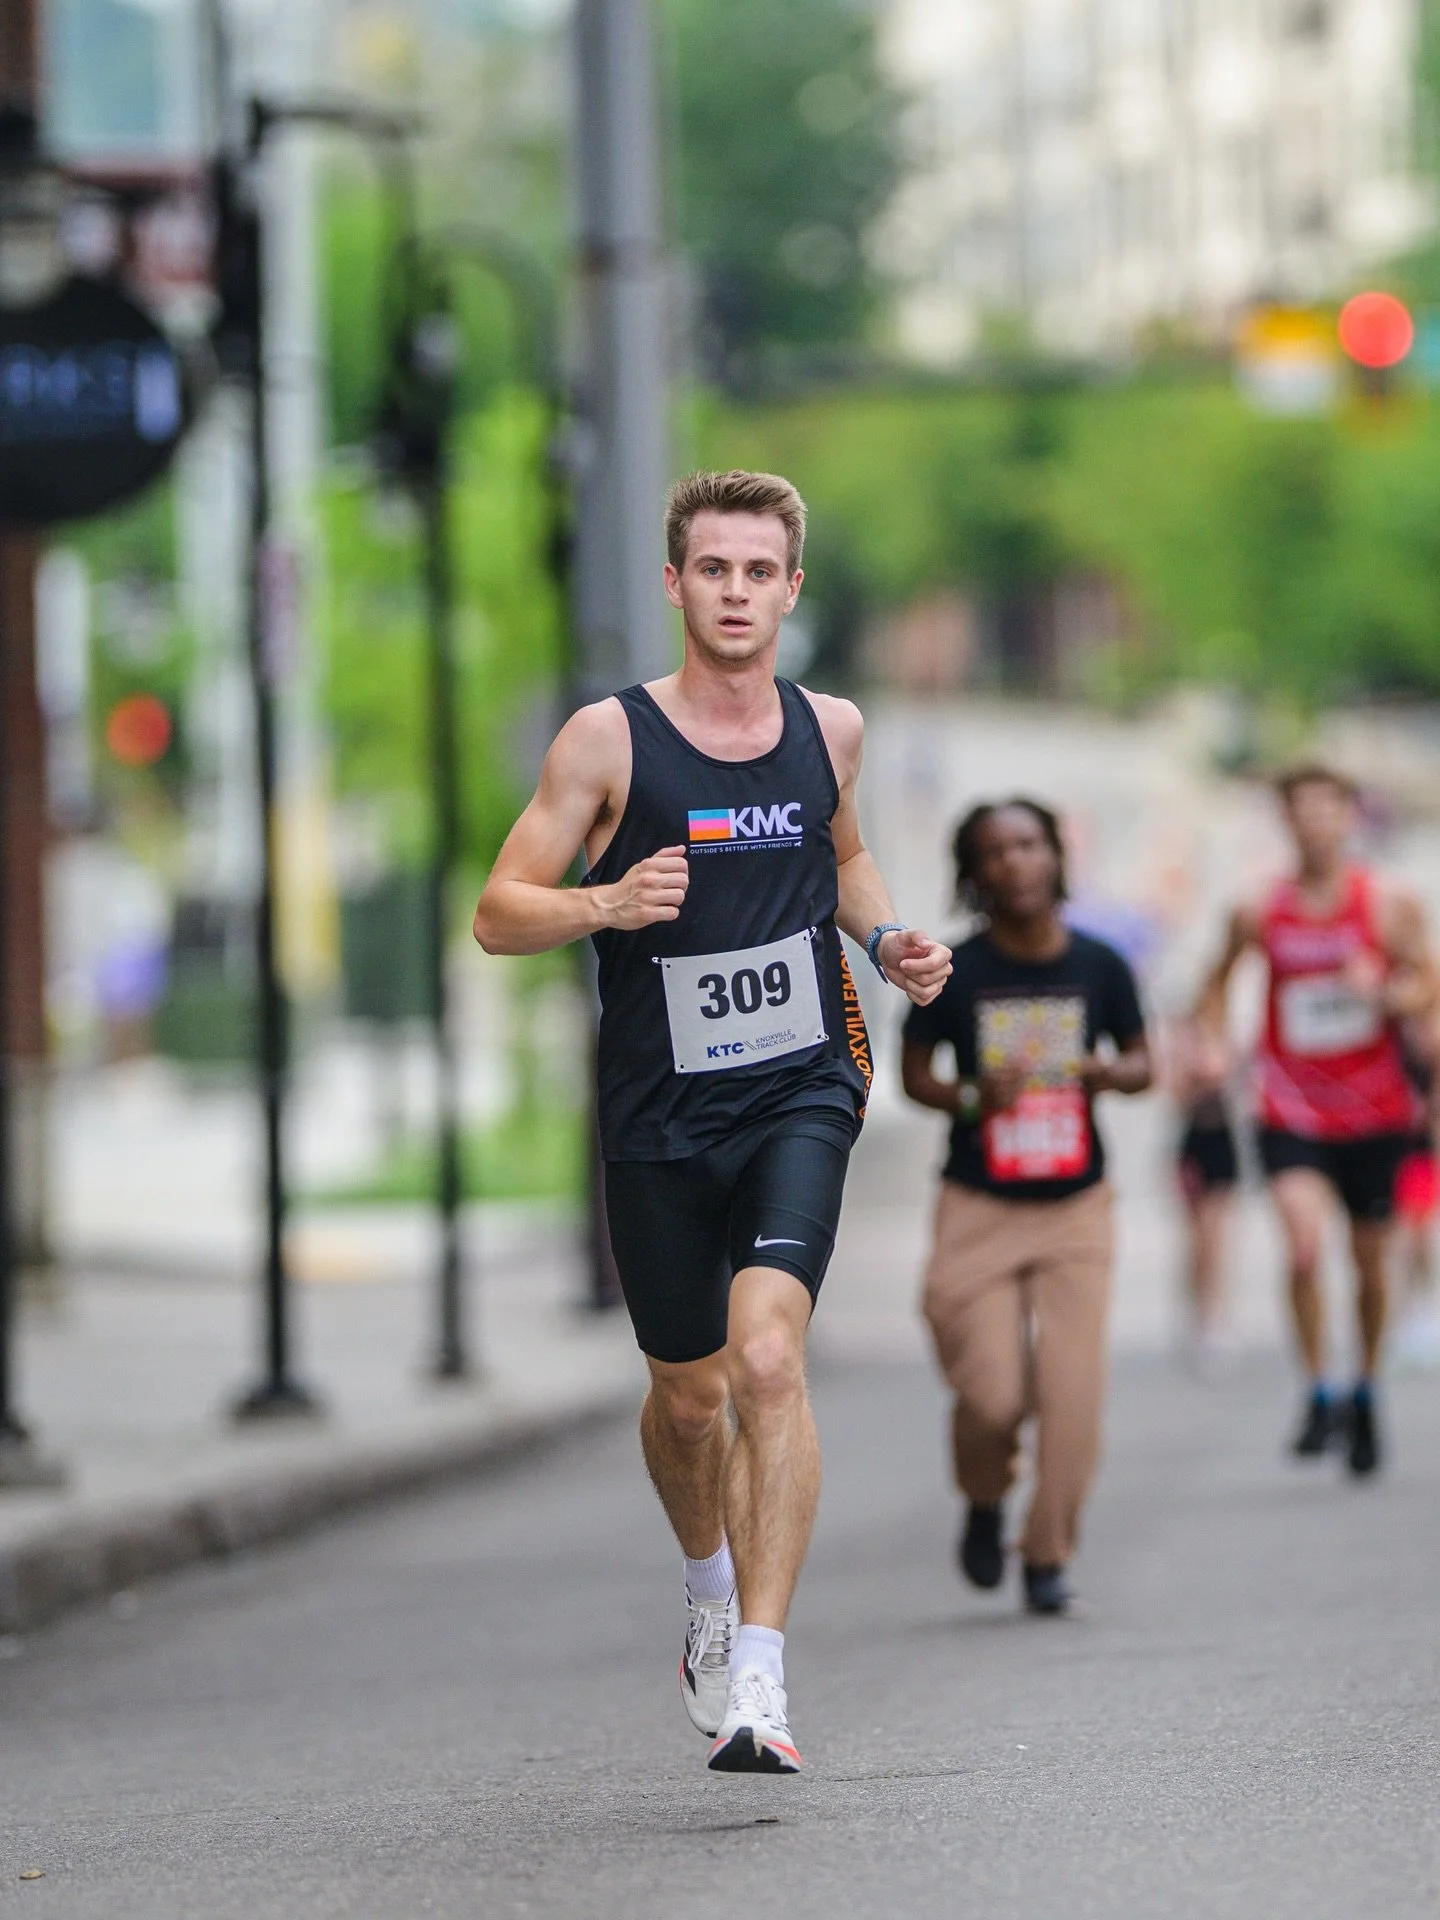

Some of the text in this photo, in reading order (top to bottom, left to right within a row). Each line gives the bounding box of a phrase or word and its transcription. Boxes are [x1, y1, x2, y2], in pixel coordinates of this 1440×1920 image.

[728, 802, 803, 838] KMC
[690, 847, 723, 855] OUTSIDE'S
[768, 841, 792, 849] FRIENDS
[698, 961, 791, 1019] 309
[755, 1029, 792, 1044] KNOXVILLE
[756, 1033, 797, 1050] TRACK CLUB
[707, 1042, 745, 1058] KTC
